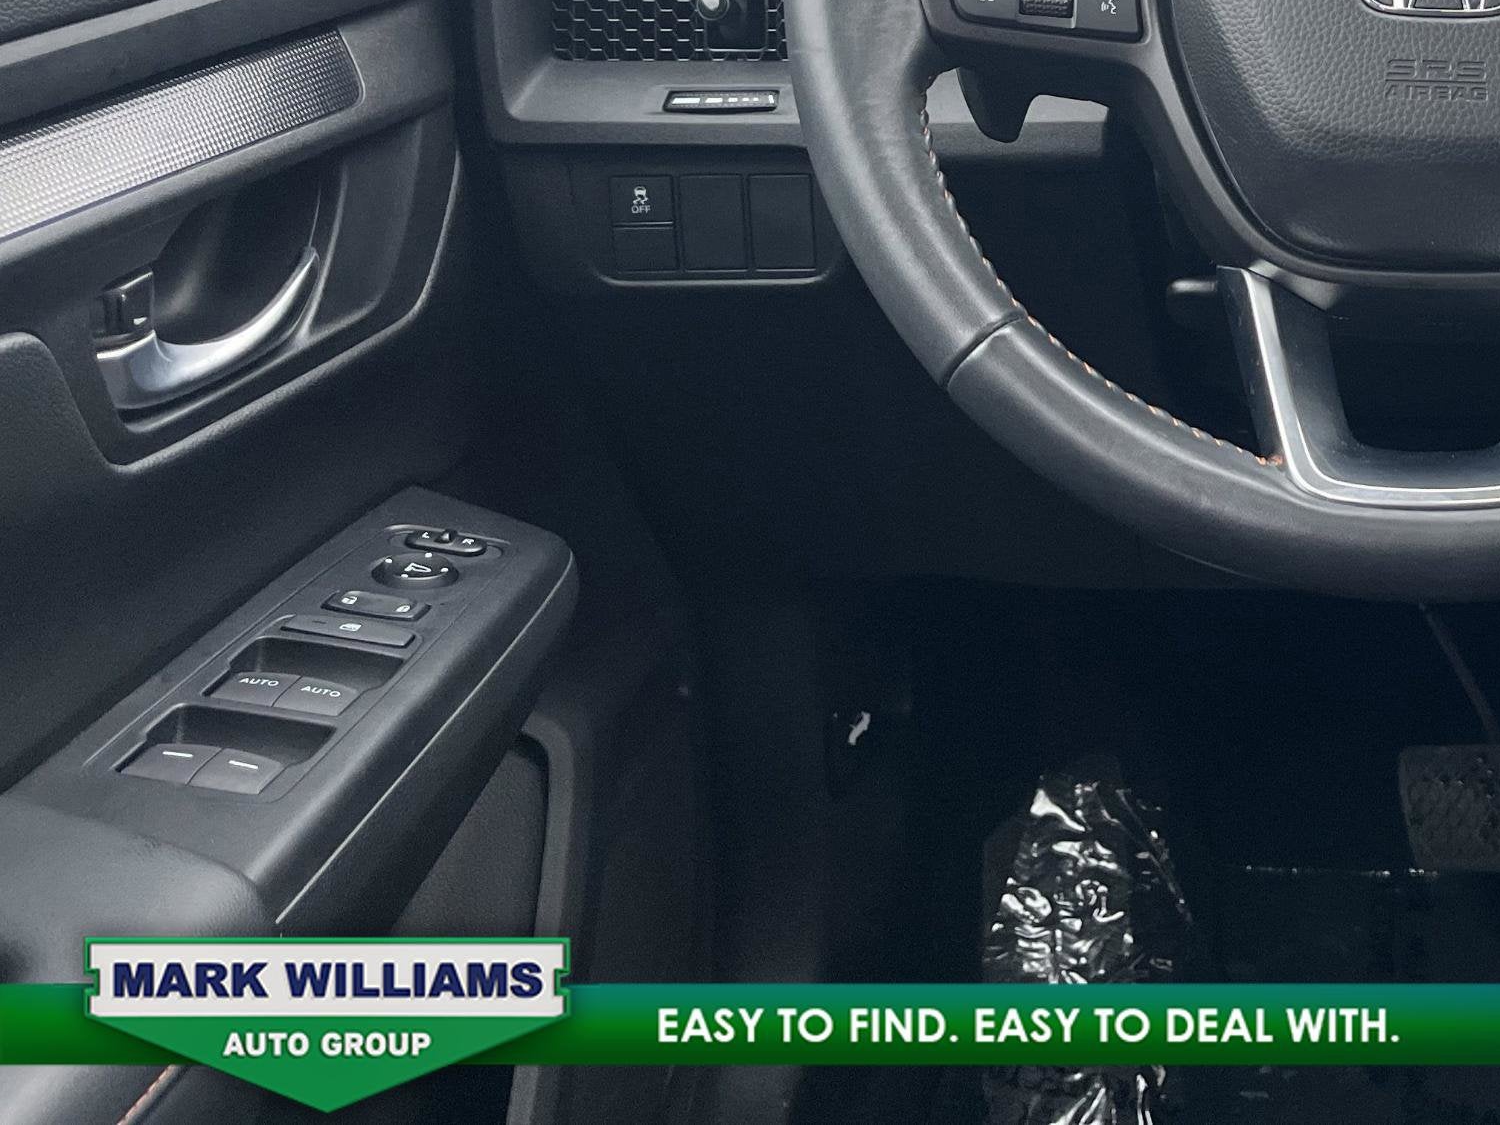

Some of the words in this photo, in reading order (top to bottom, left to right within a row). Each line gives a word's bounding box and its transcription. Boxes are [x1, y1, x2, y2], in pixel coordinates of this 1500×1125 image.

[1384, 84, 1490, 102] AIRBAG
[631, 205, 651, 214] OFF
[240, 677, 279, 687] AUTO
[300, 685, 341, 698] AUTO
